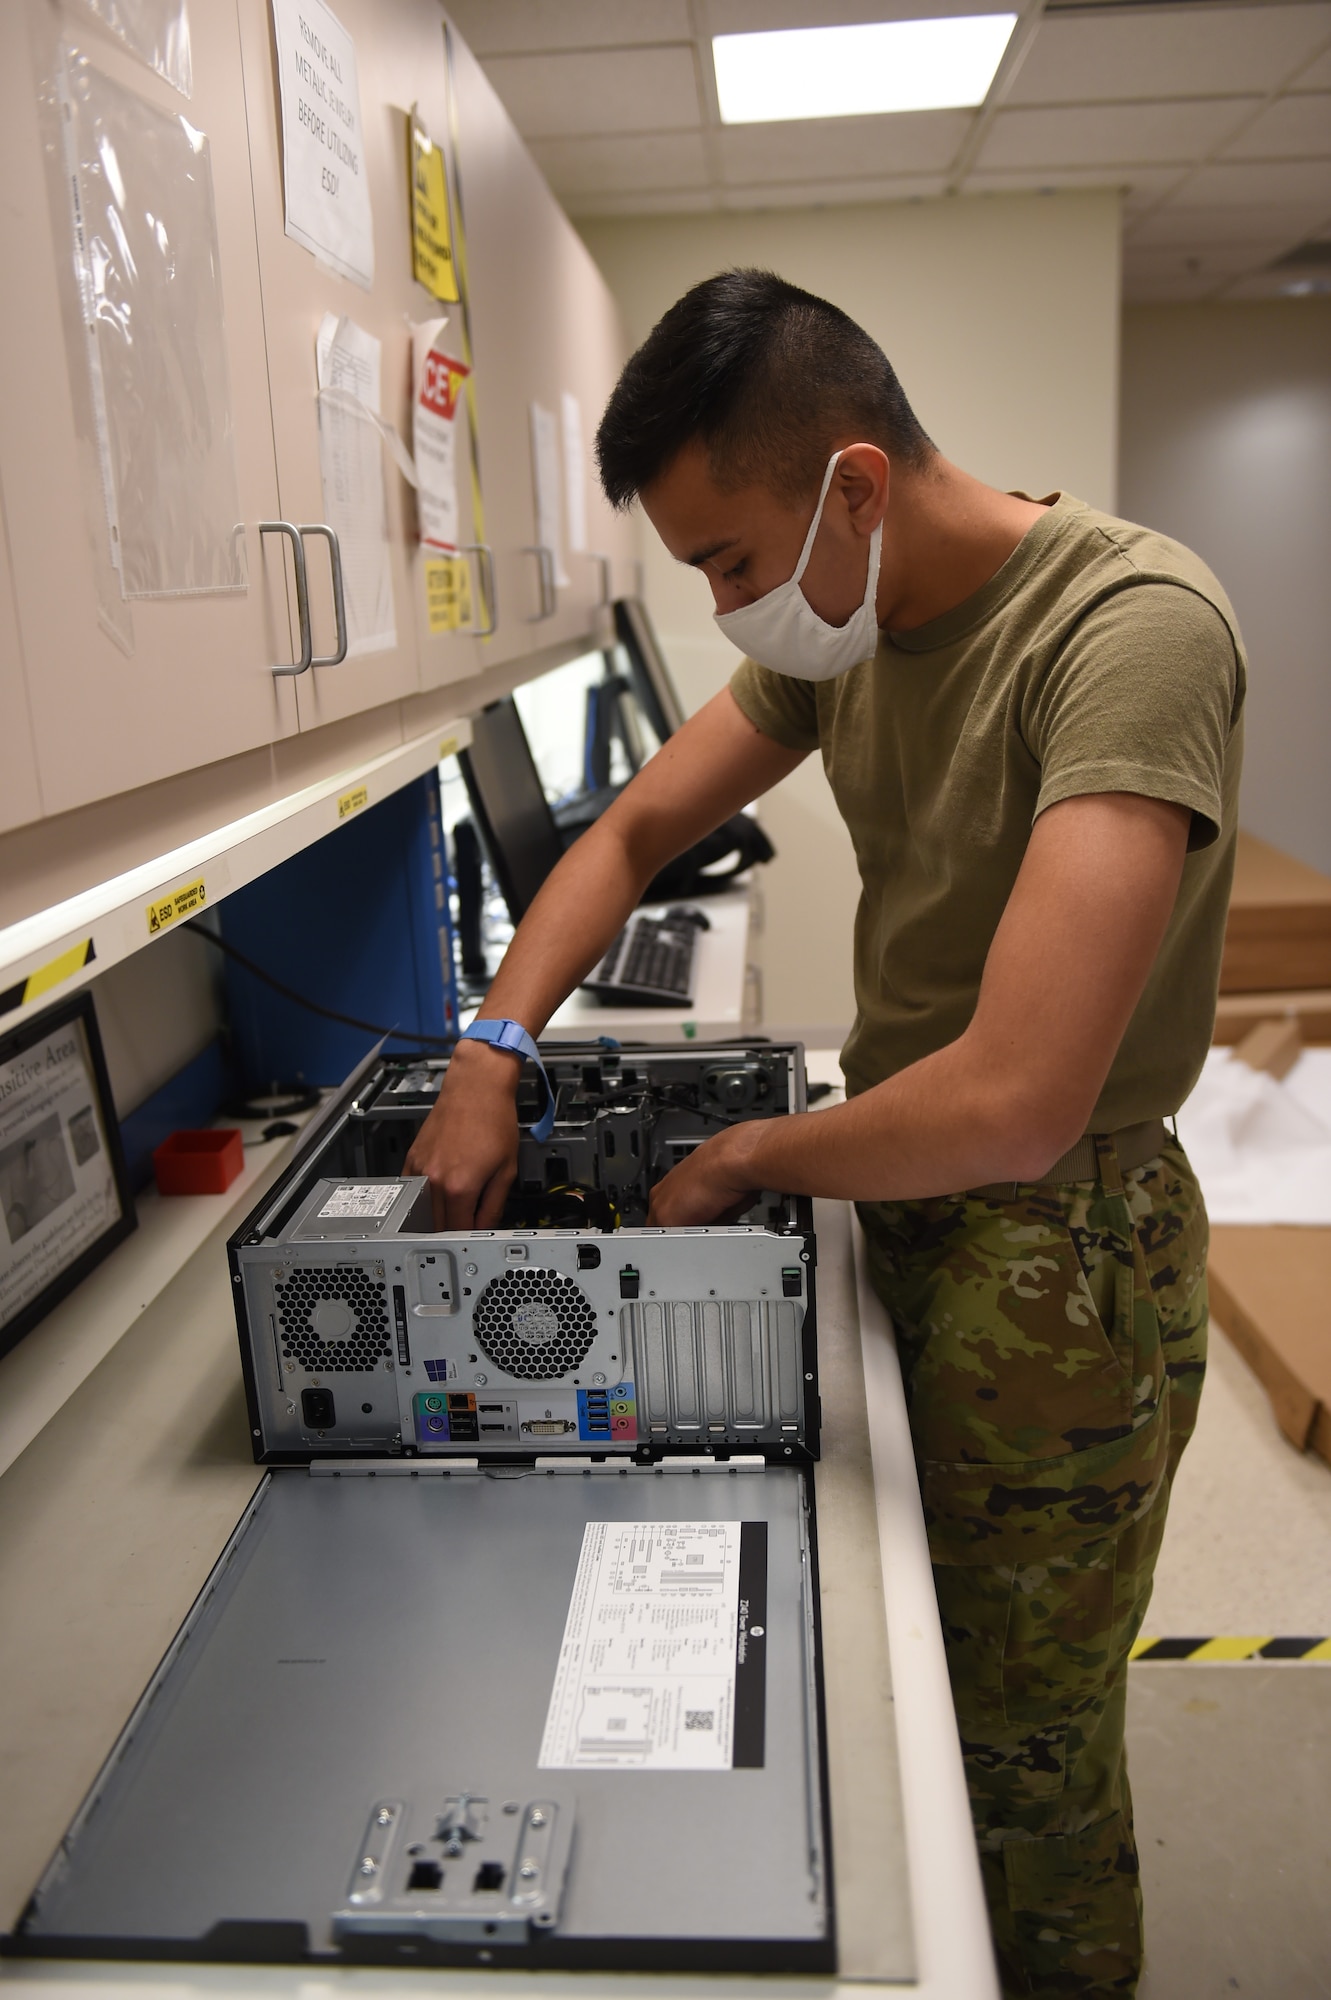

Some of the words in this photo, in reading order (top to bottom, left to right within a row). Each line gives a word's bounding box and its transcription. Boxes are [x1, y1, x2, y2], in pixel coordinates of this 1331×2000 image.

[298, 14, 330, 70] REMOVE
[330, 51, 344, 85] ALL
[298, 97, 326, 145] BEFORE
[327, 127, 359, 176] UTILIZING
[321, 166, 341, 199] ESD!
[159, 904, 172, 922] ESD
[174, 887, 198, 905] SAFEGUARDED
[46, 1040, 77, 1070] Area
